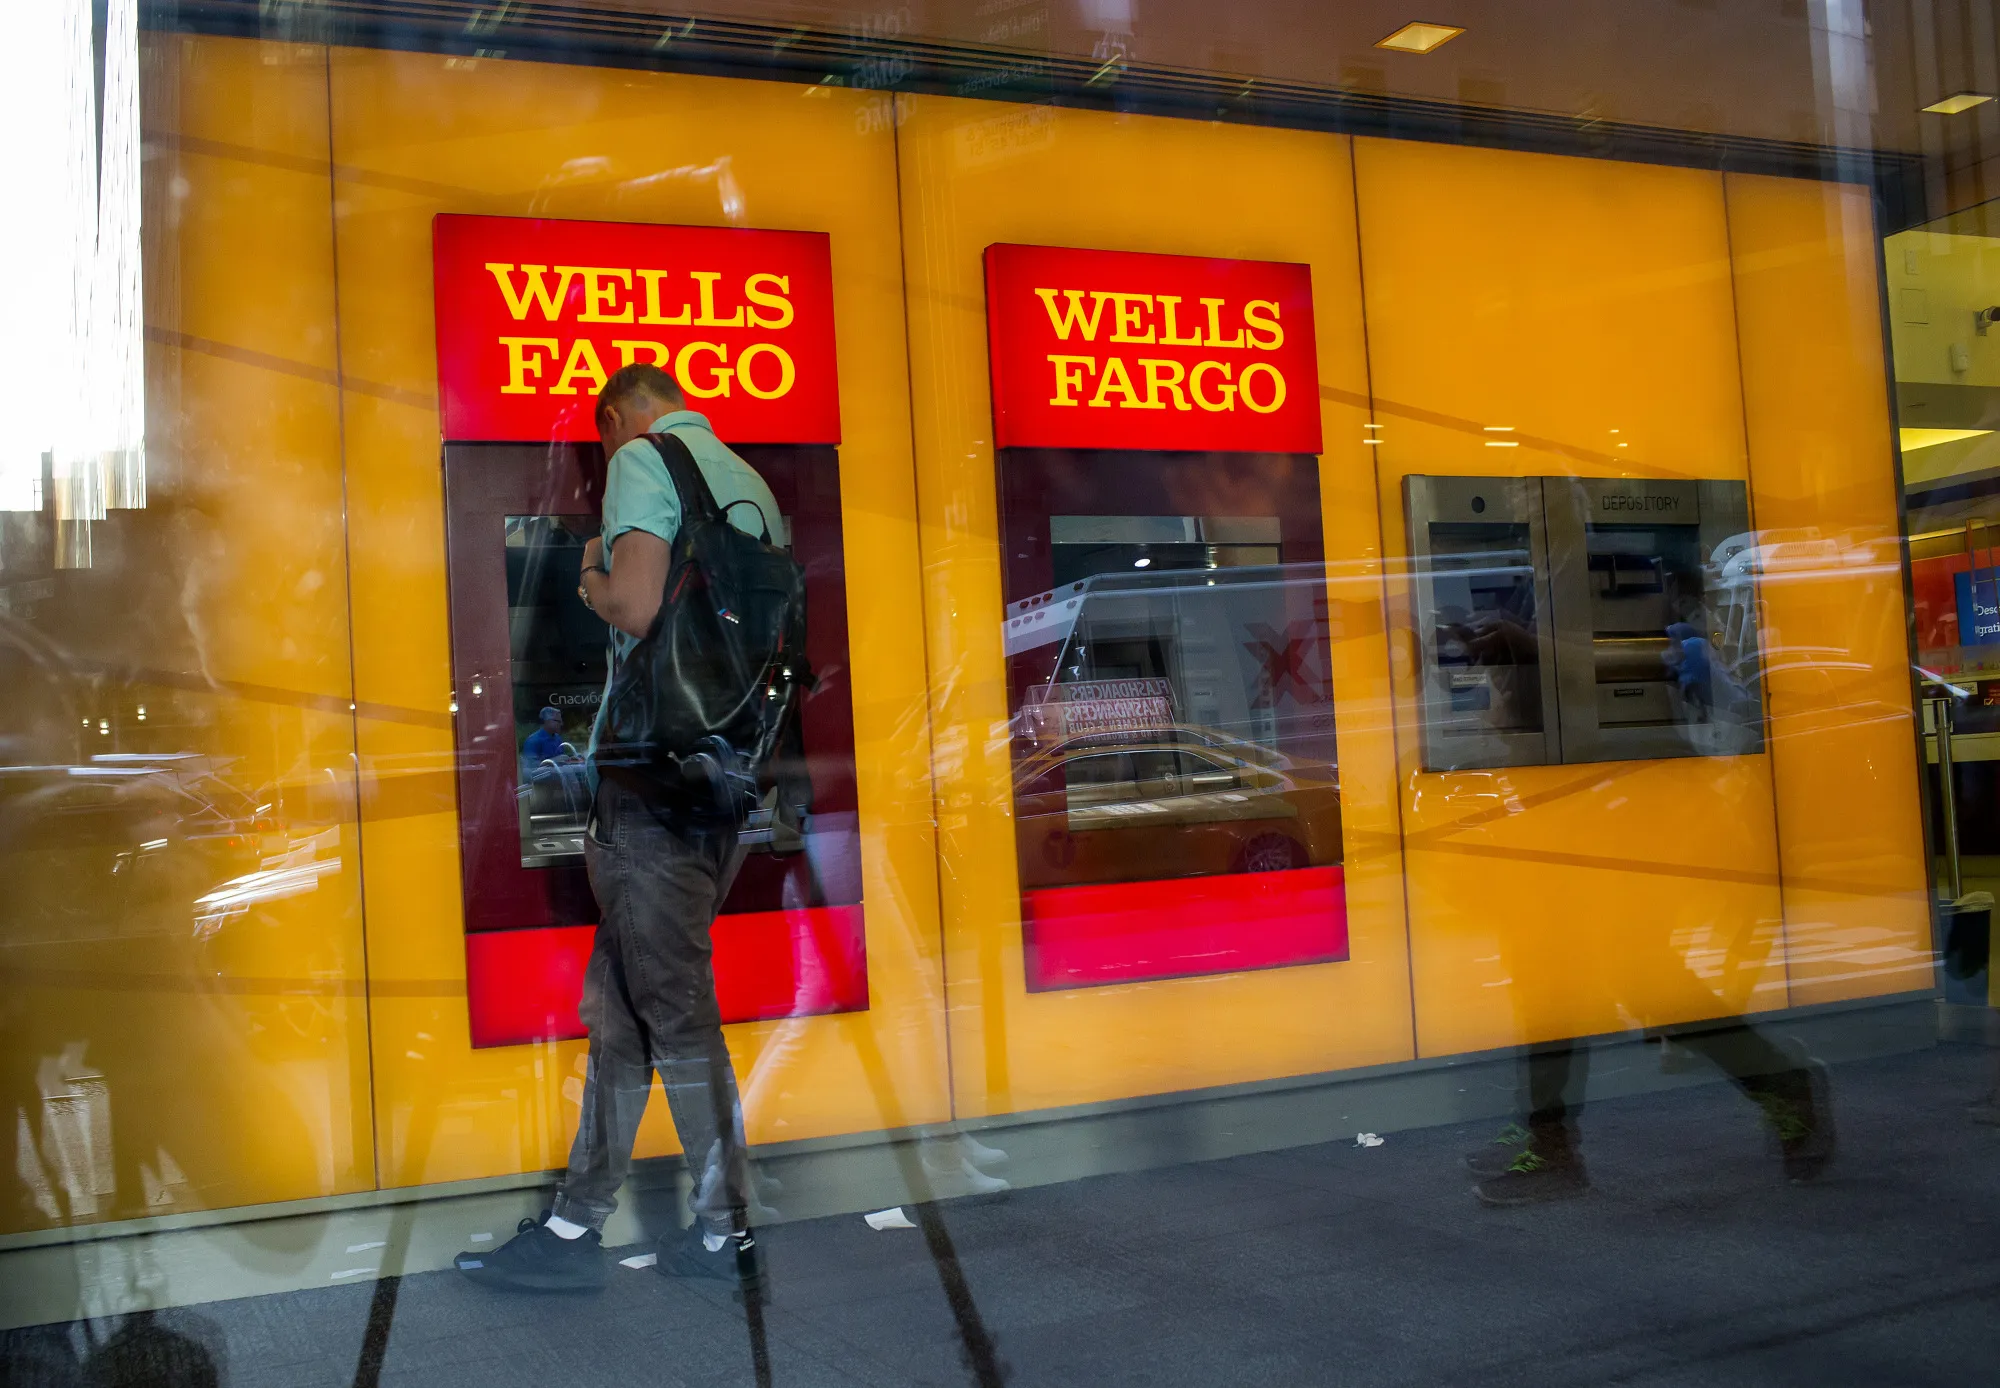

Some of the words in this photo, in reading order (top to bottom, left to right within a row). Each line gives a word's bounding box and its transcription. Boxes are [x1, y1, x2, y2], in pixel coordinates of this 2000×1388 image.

[485, 263, 794, 329] WELLS
[1034, 288, 1285, 351] WELLS
[1047, 354, 1287, 414] FARGO
[1602, 496, 1679, 511] DEPOSITORY
